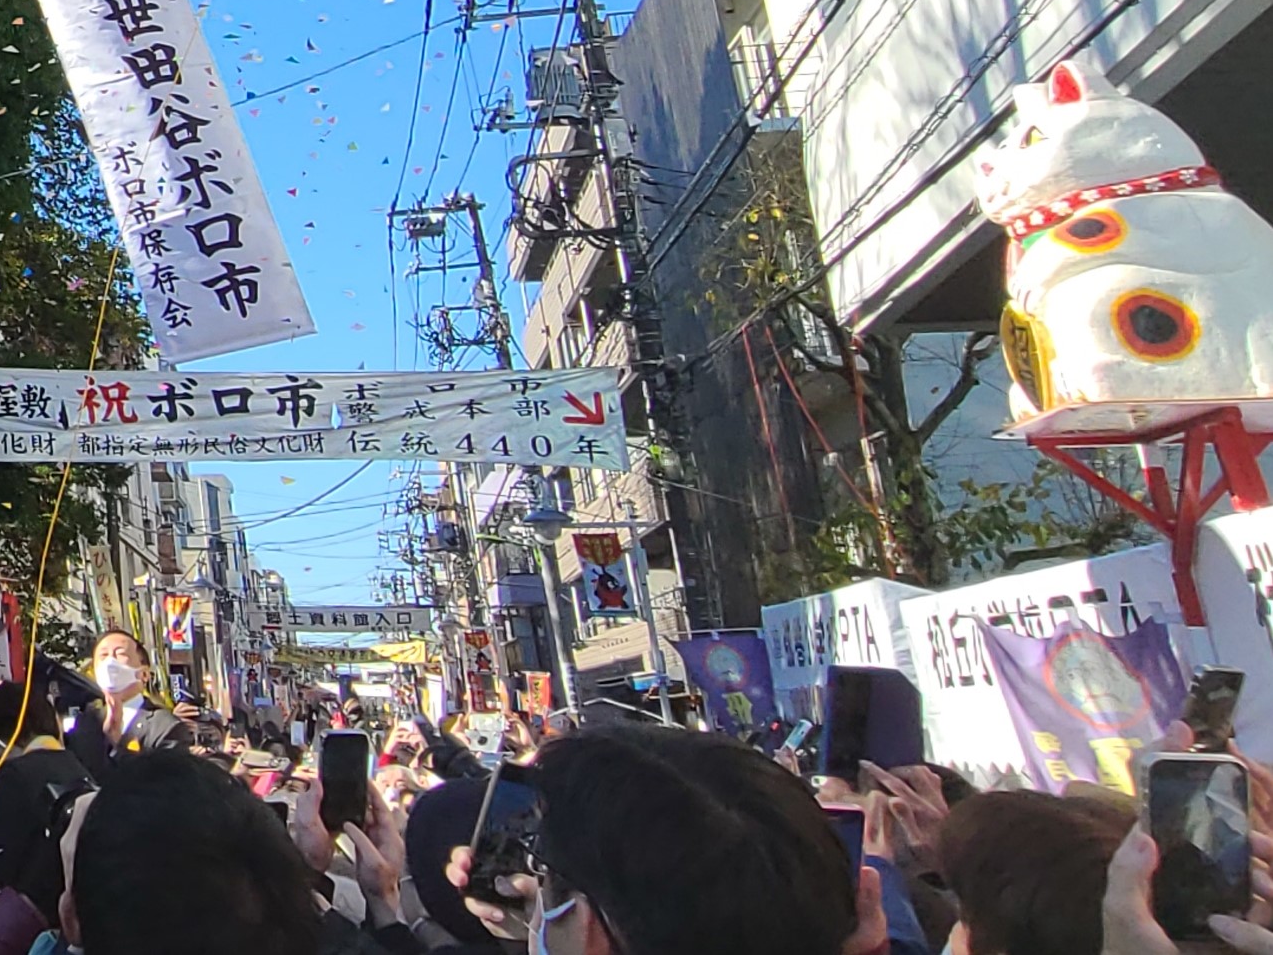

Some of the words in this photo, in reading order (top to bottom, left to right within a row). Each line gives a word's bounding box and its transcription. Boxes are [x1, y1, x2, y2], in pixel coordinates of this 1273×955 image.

[112, 140, 194, 330] ボロ市保存会
[342, 376, 550, 401] ボロ市
[77, 431, 326, 457] 都指定無形民俗文化財
